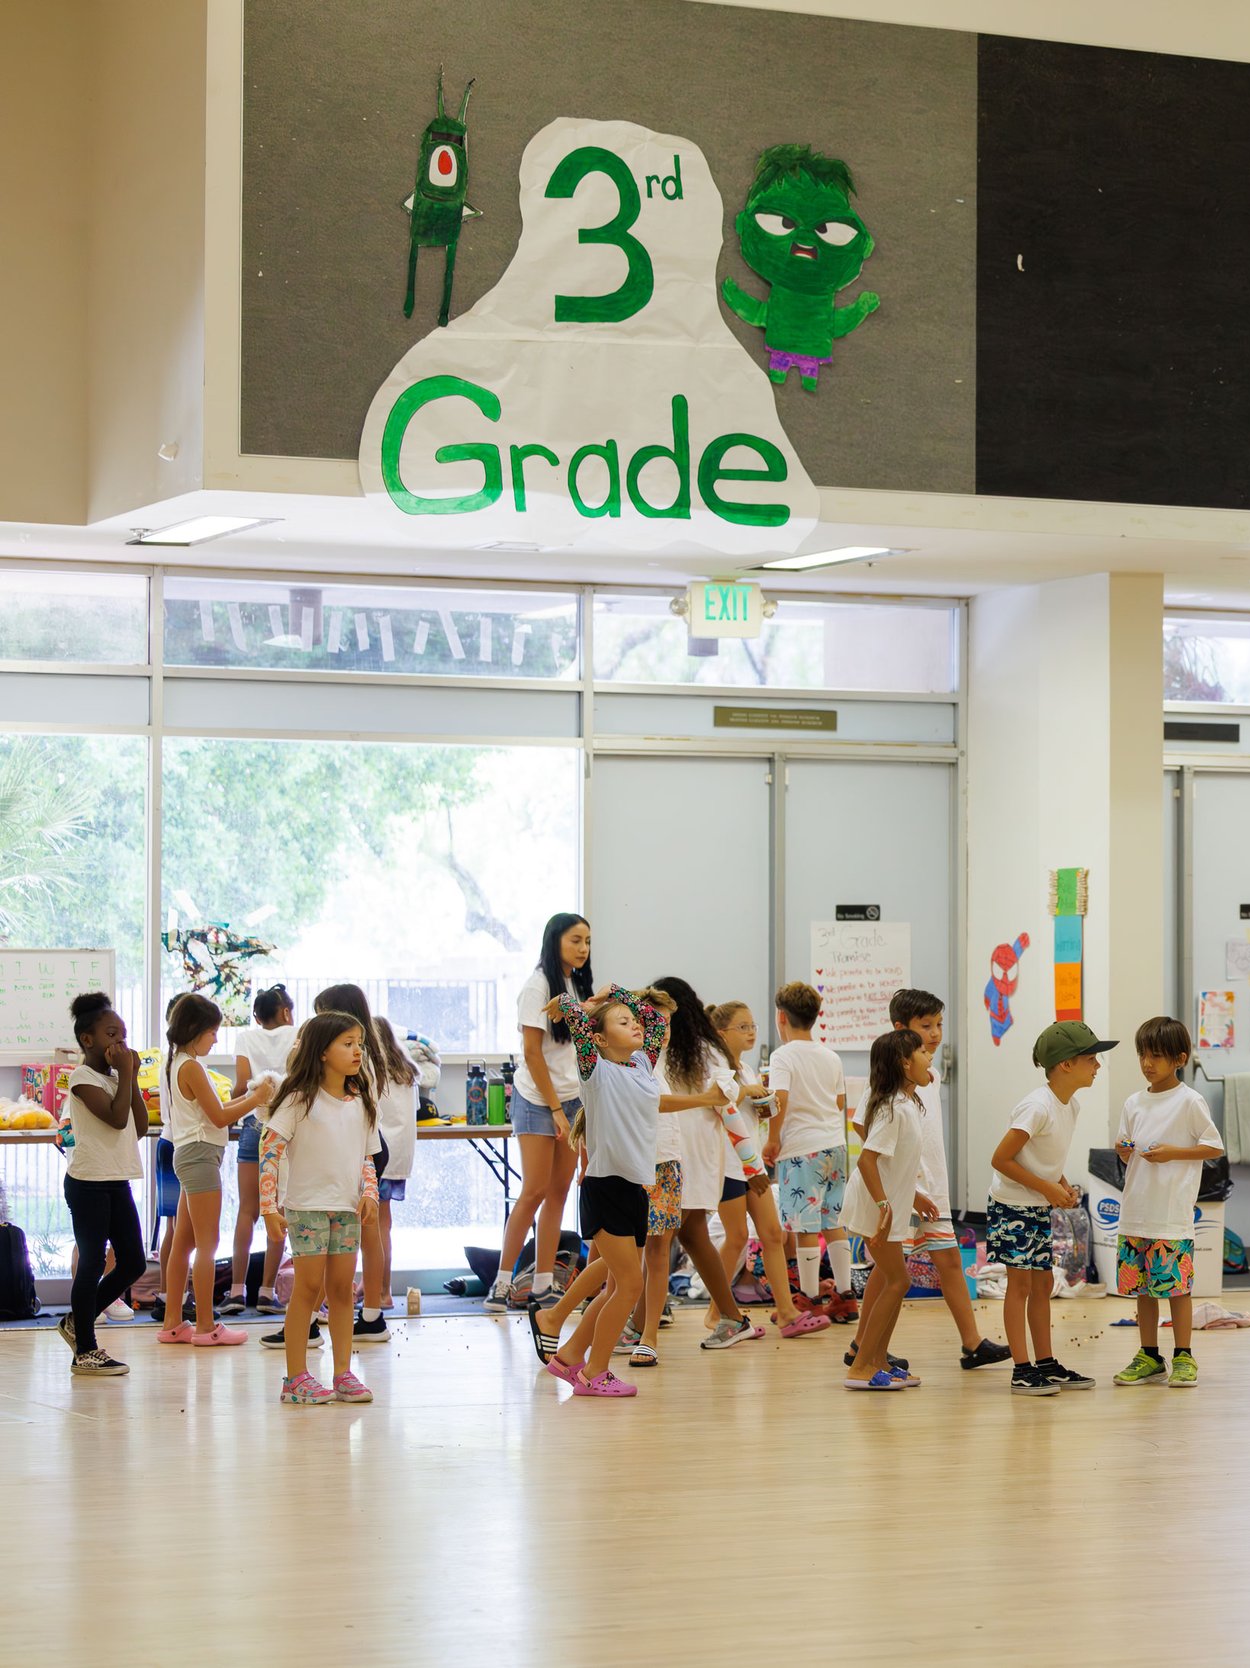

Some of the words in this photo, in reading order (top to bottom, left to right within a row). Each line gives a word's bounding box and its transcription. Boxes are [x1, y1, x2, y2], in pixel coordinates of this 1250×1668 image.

[545, 146, 683, 322] 3rd
[381, 375, 790, 527] Grade
[704, 585, 753, 621] EXIT
[840, 924, 887, 949] Grade
